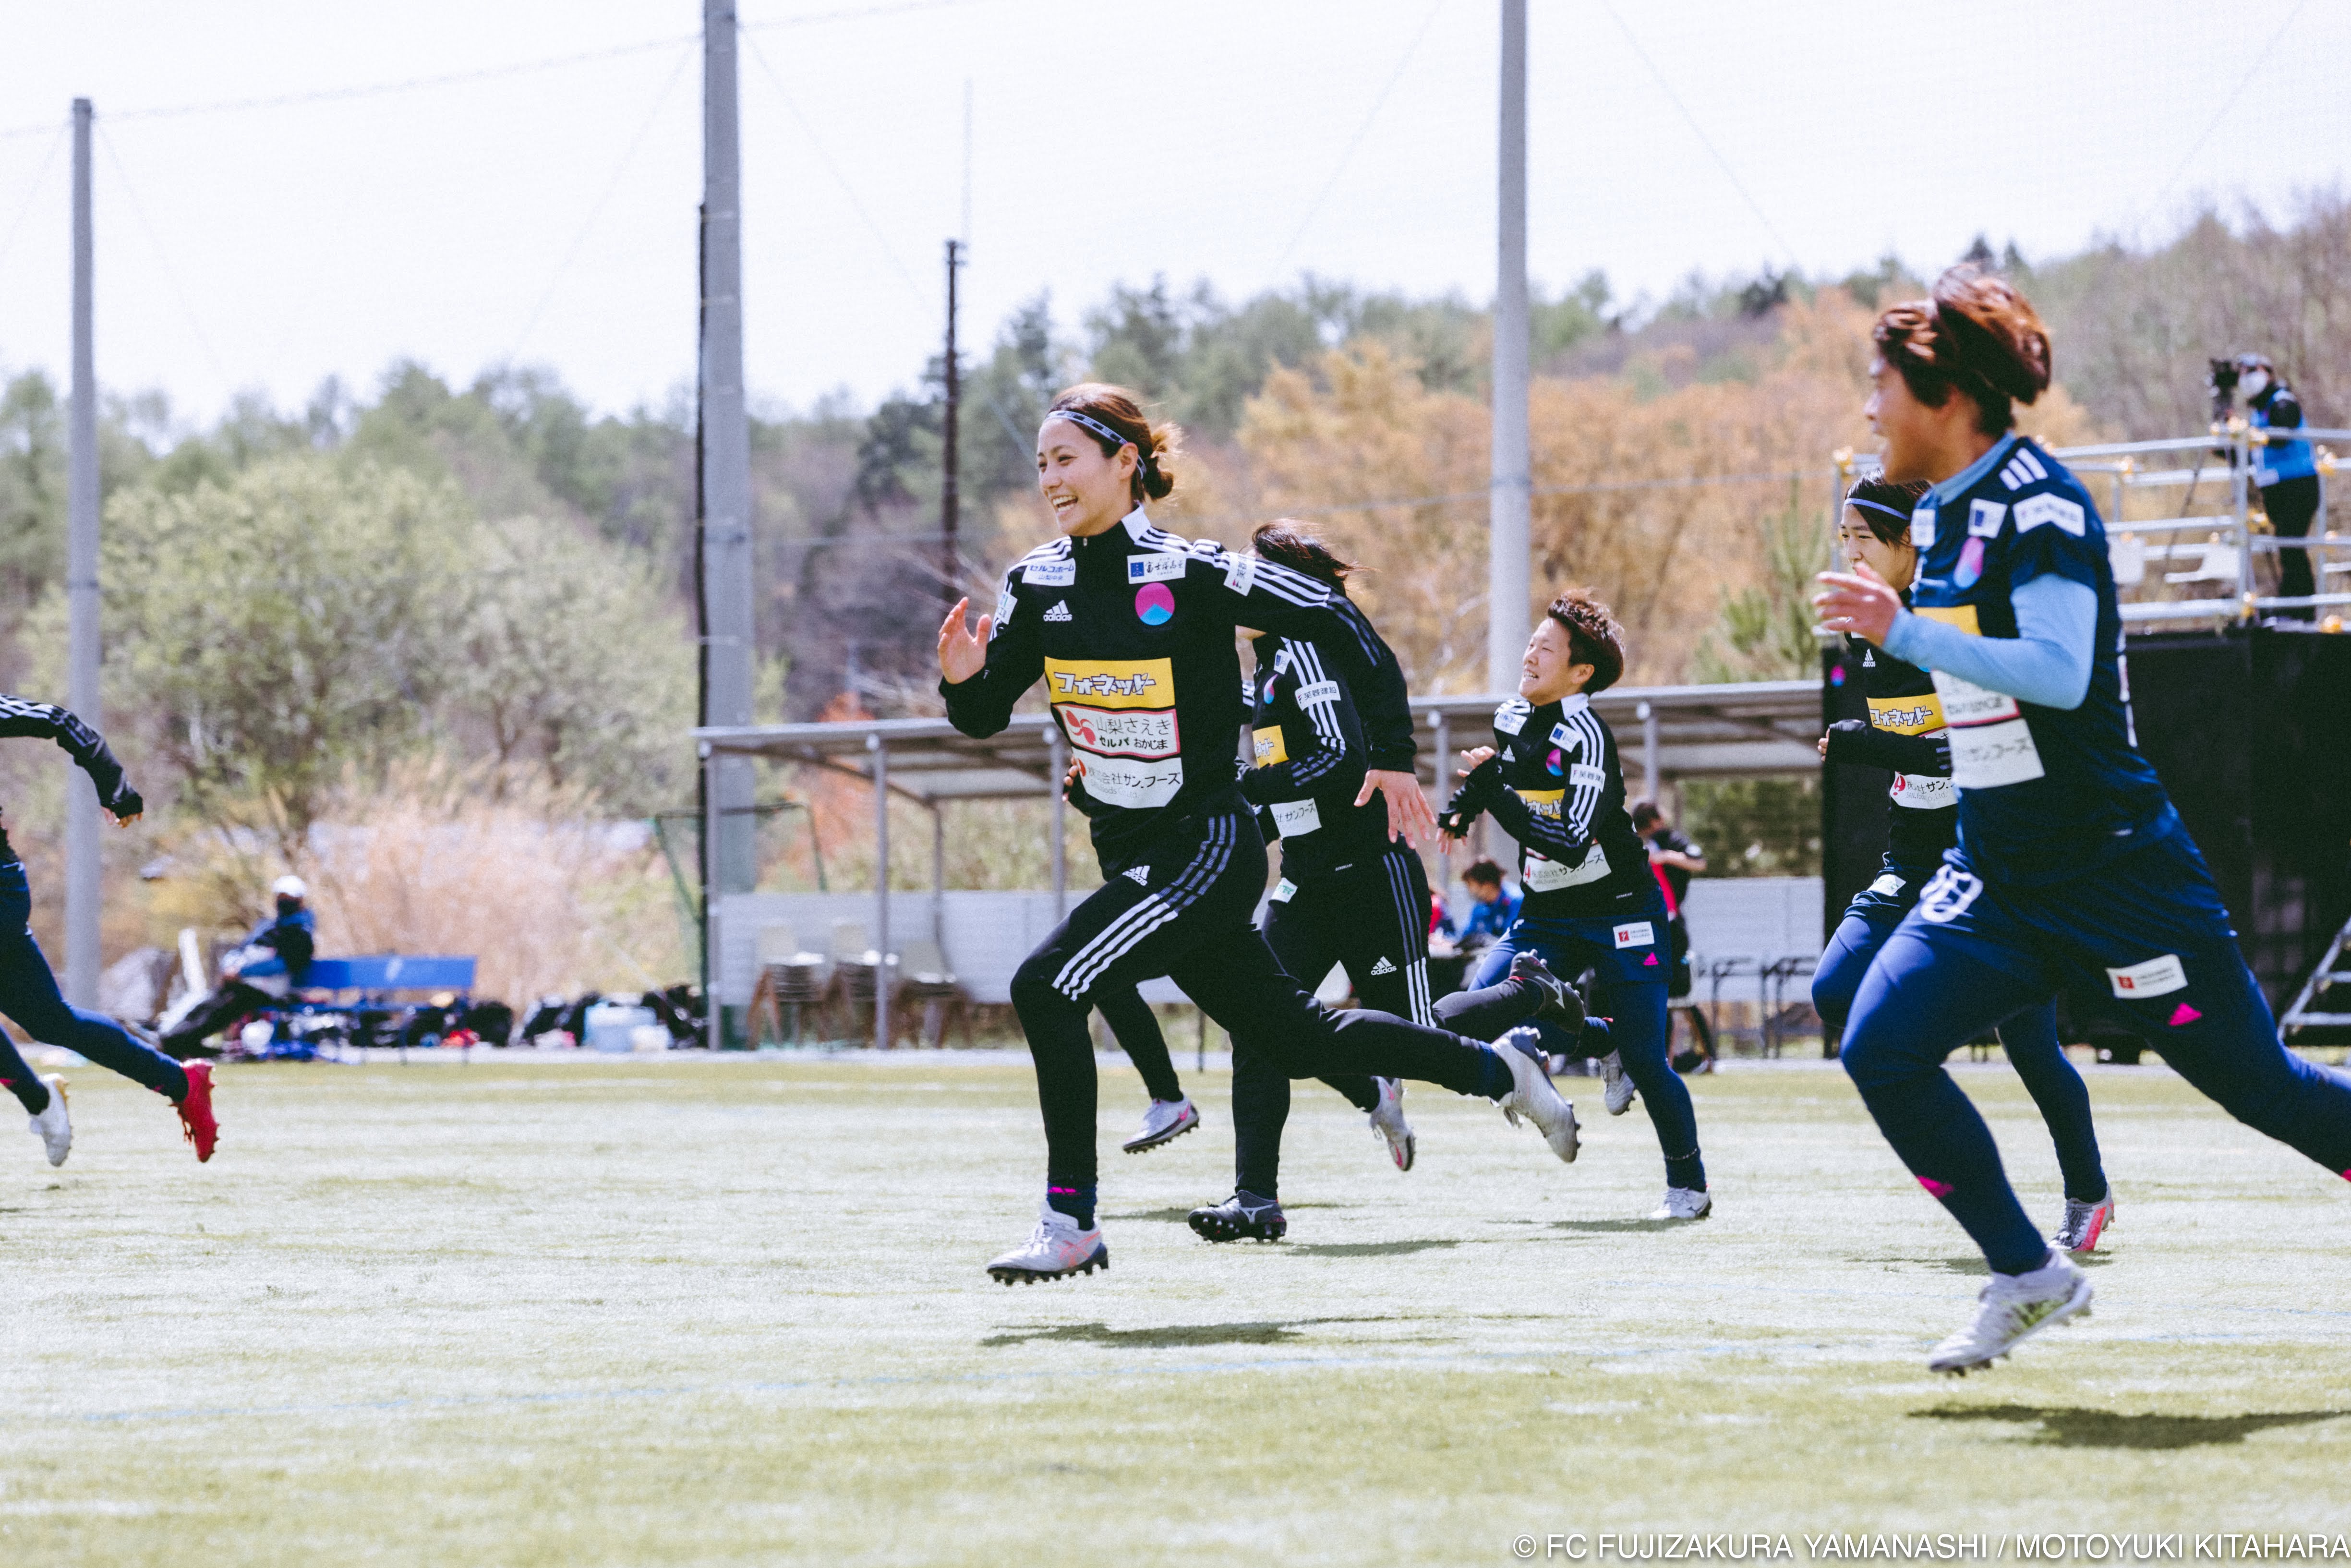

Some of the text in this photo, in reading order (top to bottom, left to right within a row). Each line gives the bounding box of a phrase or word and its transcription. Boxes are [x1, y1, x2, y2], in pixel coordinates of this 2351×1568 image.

[1030, 564, 1074, 573] セルコホーム
[1043, 614, 1073, 622] adidas
[1054, 672, 1156, 696] フォネット
[1869, 705, 1933, 726] フォネット
[1096, 717, 1170, 736] 山梨さえき
[1099, 736, 1168, 750] セルバ おかじま
[1371, 965, 1397, 976] adidas
